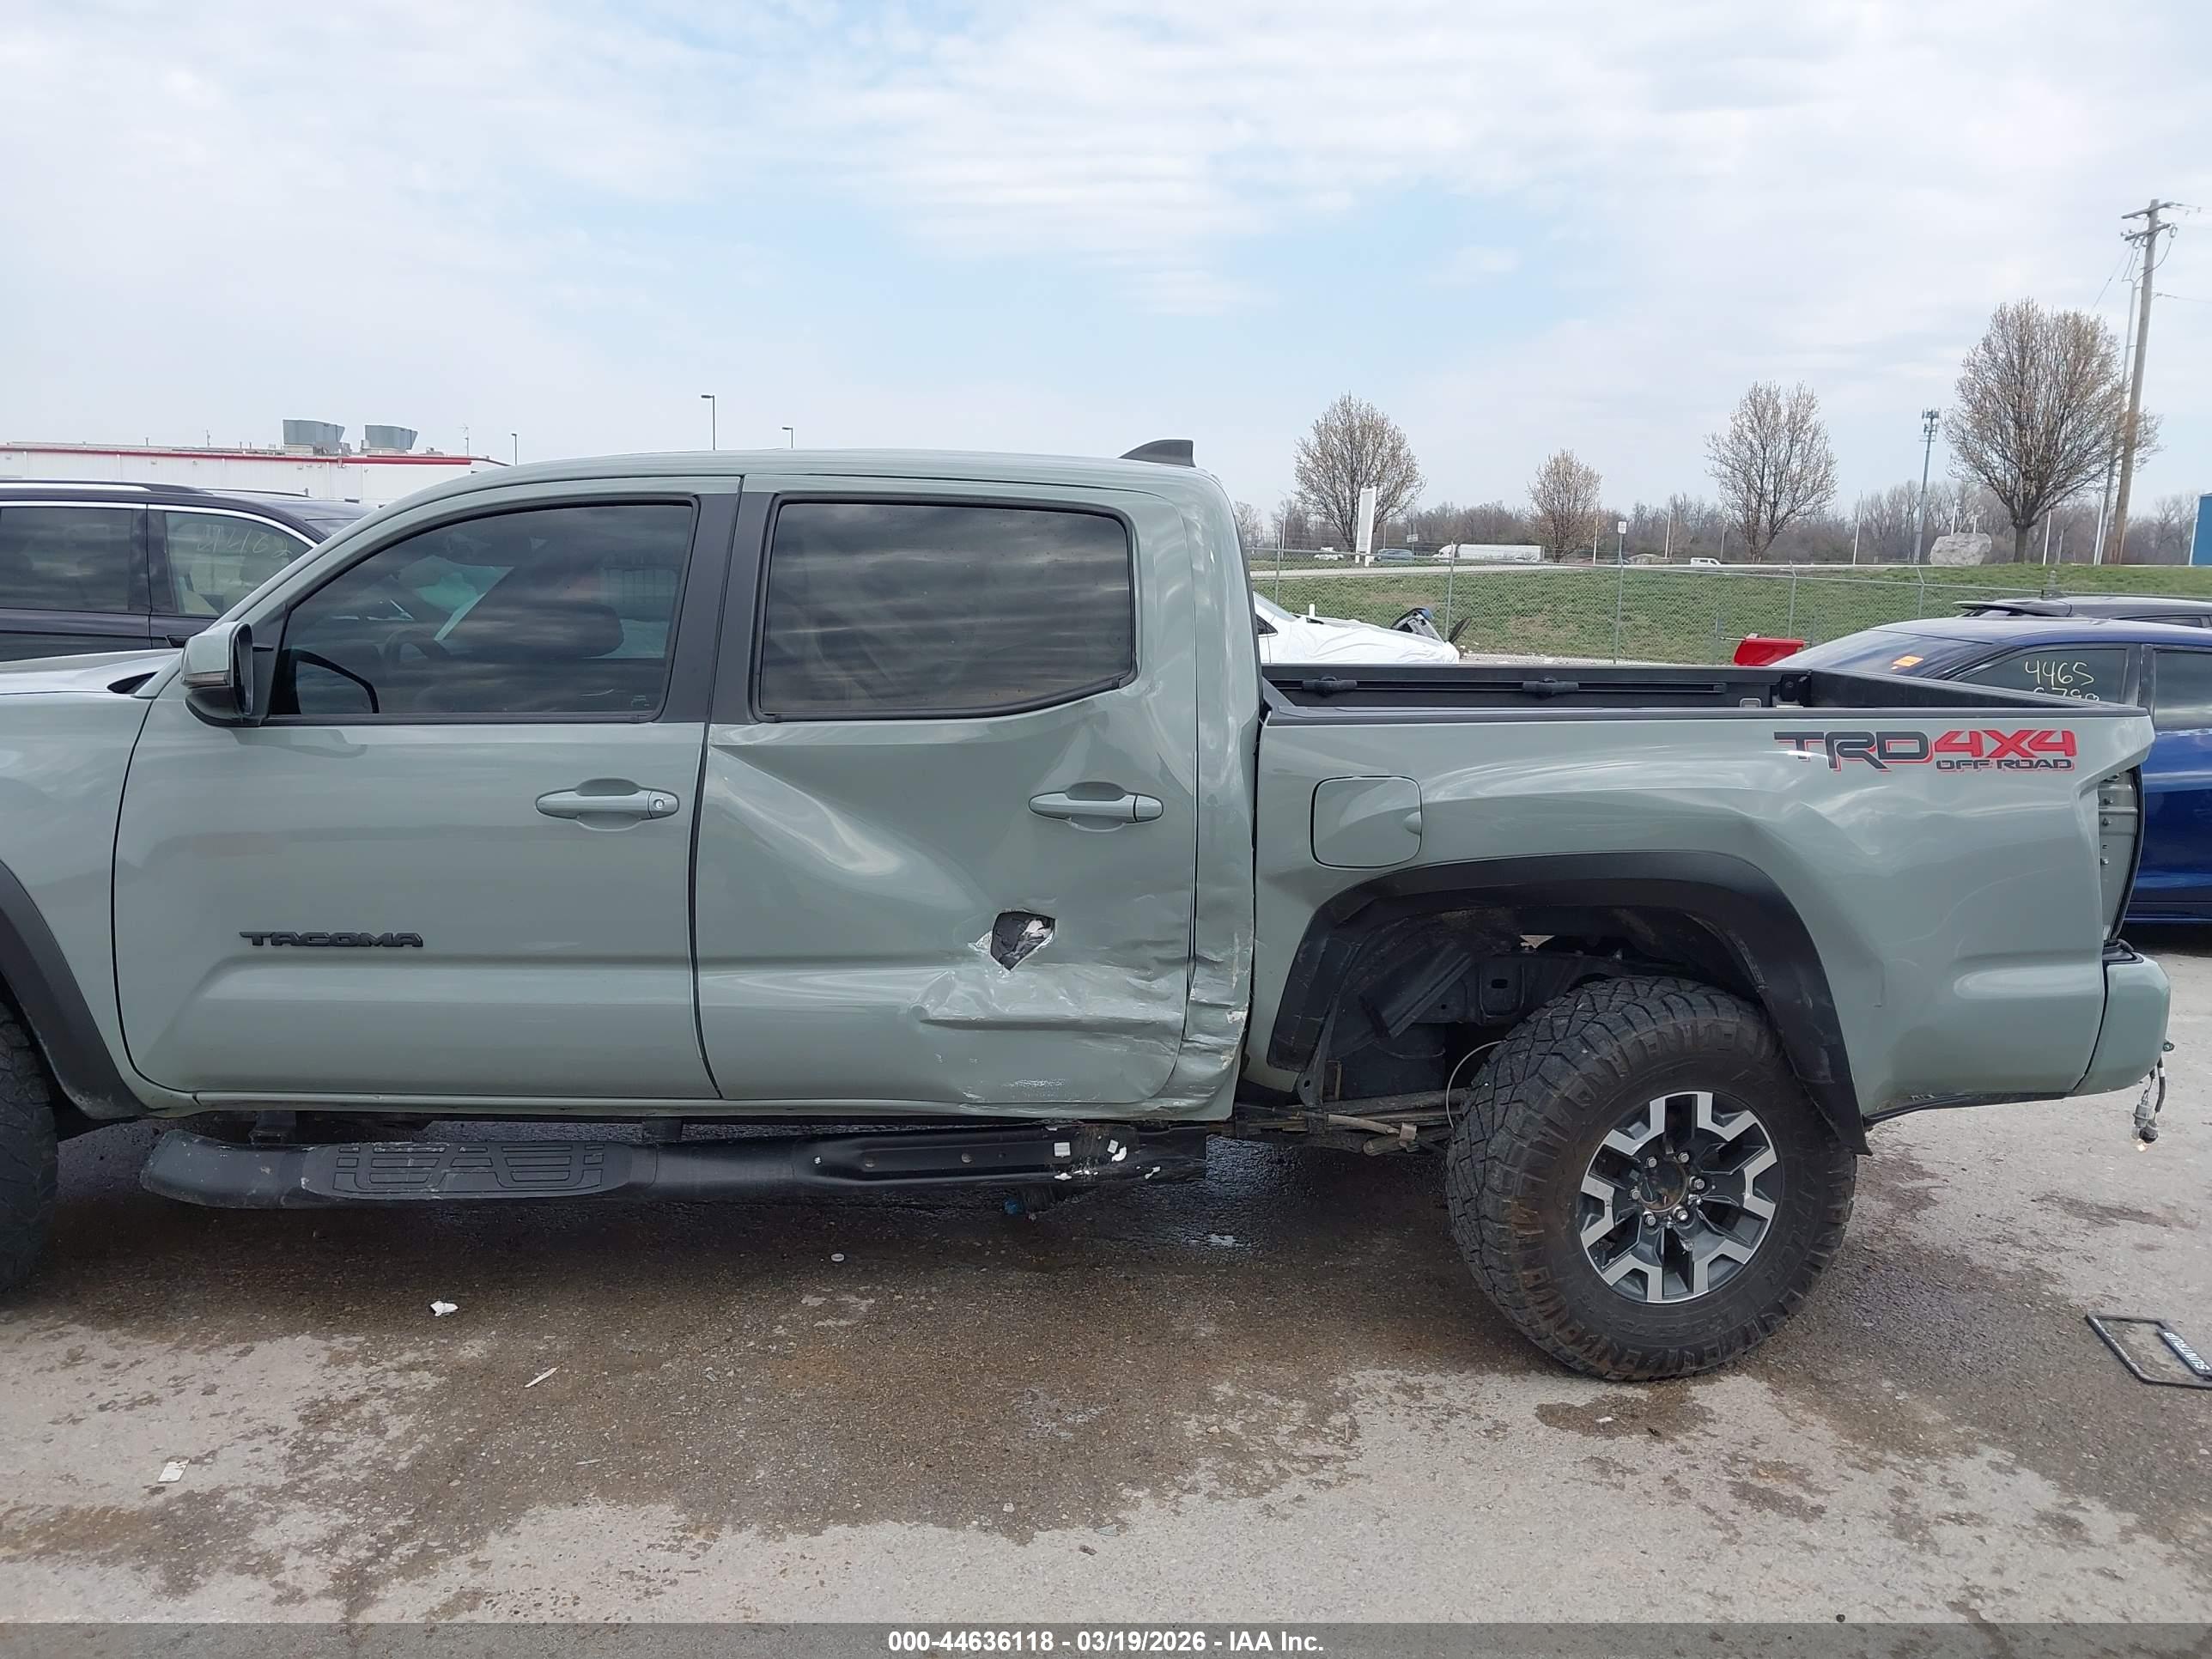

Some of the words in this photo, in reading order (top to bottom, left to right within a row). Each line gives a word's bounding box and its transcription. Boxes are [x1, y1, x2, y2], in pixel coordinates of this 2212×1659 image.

[2025, 659, 2095, 687] 4465
[1774, 731, 1933, 772] TRD
[1936, 759, 1992, 771] OFF
[1996, 759, 2075, 771] ROAD
[239, 932, 424, 948] TACOMA
